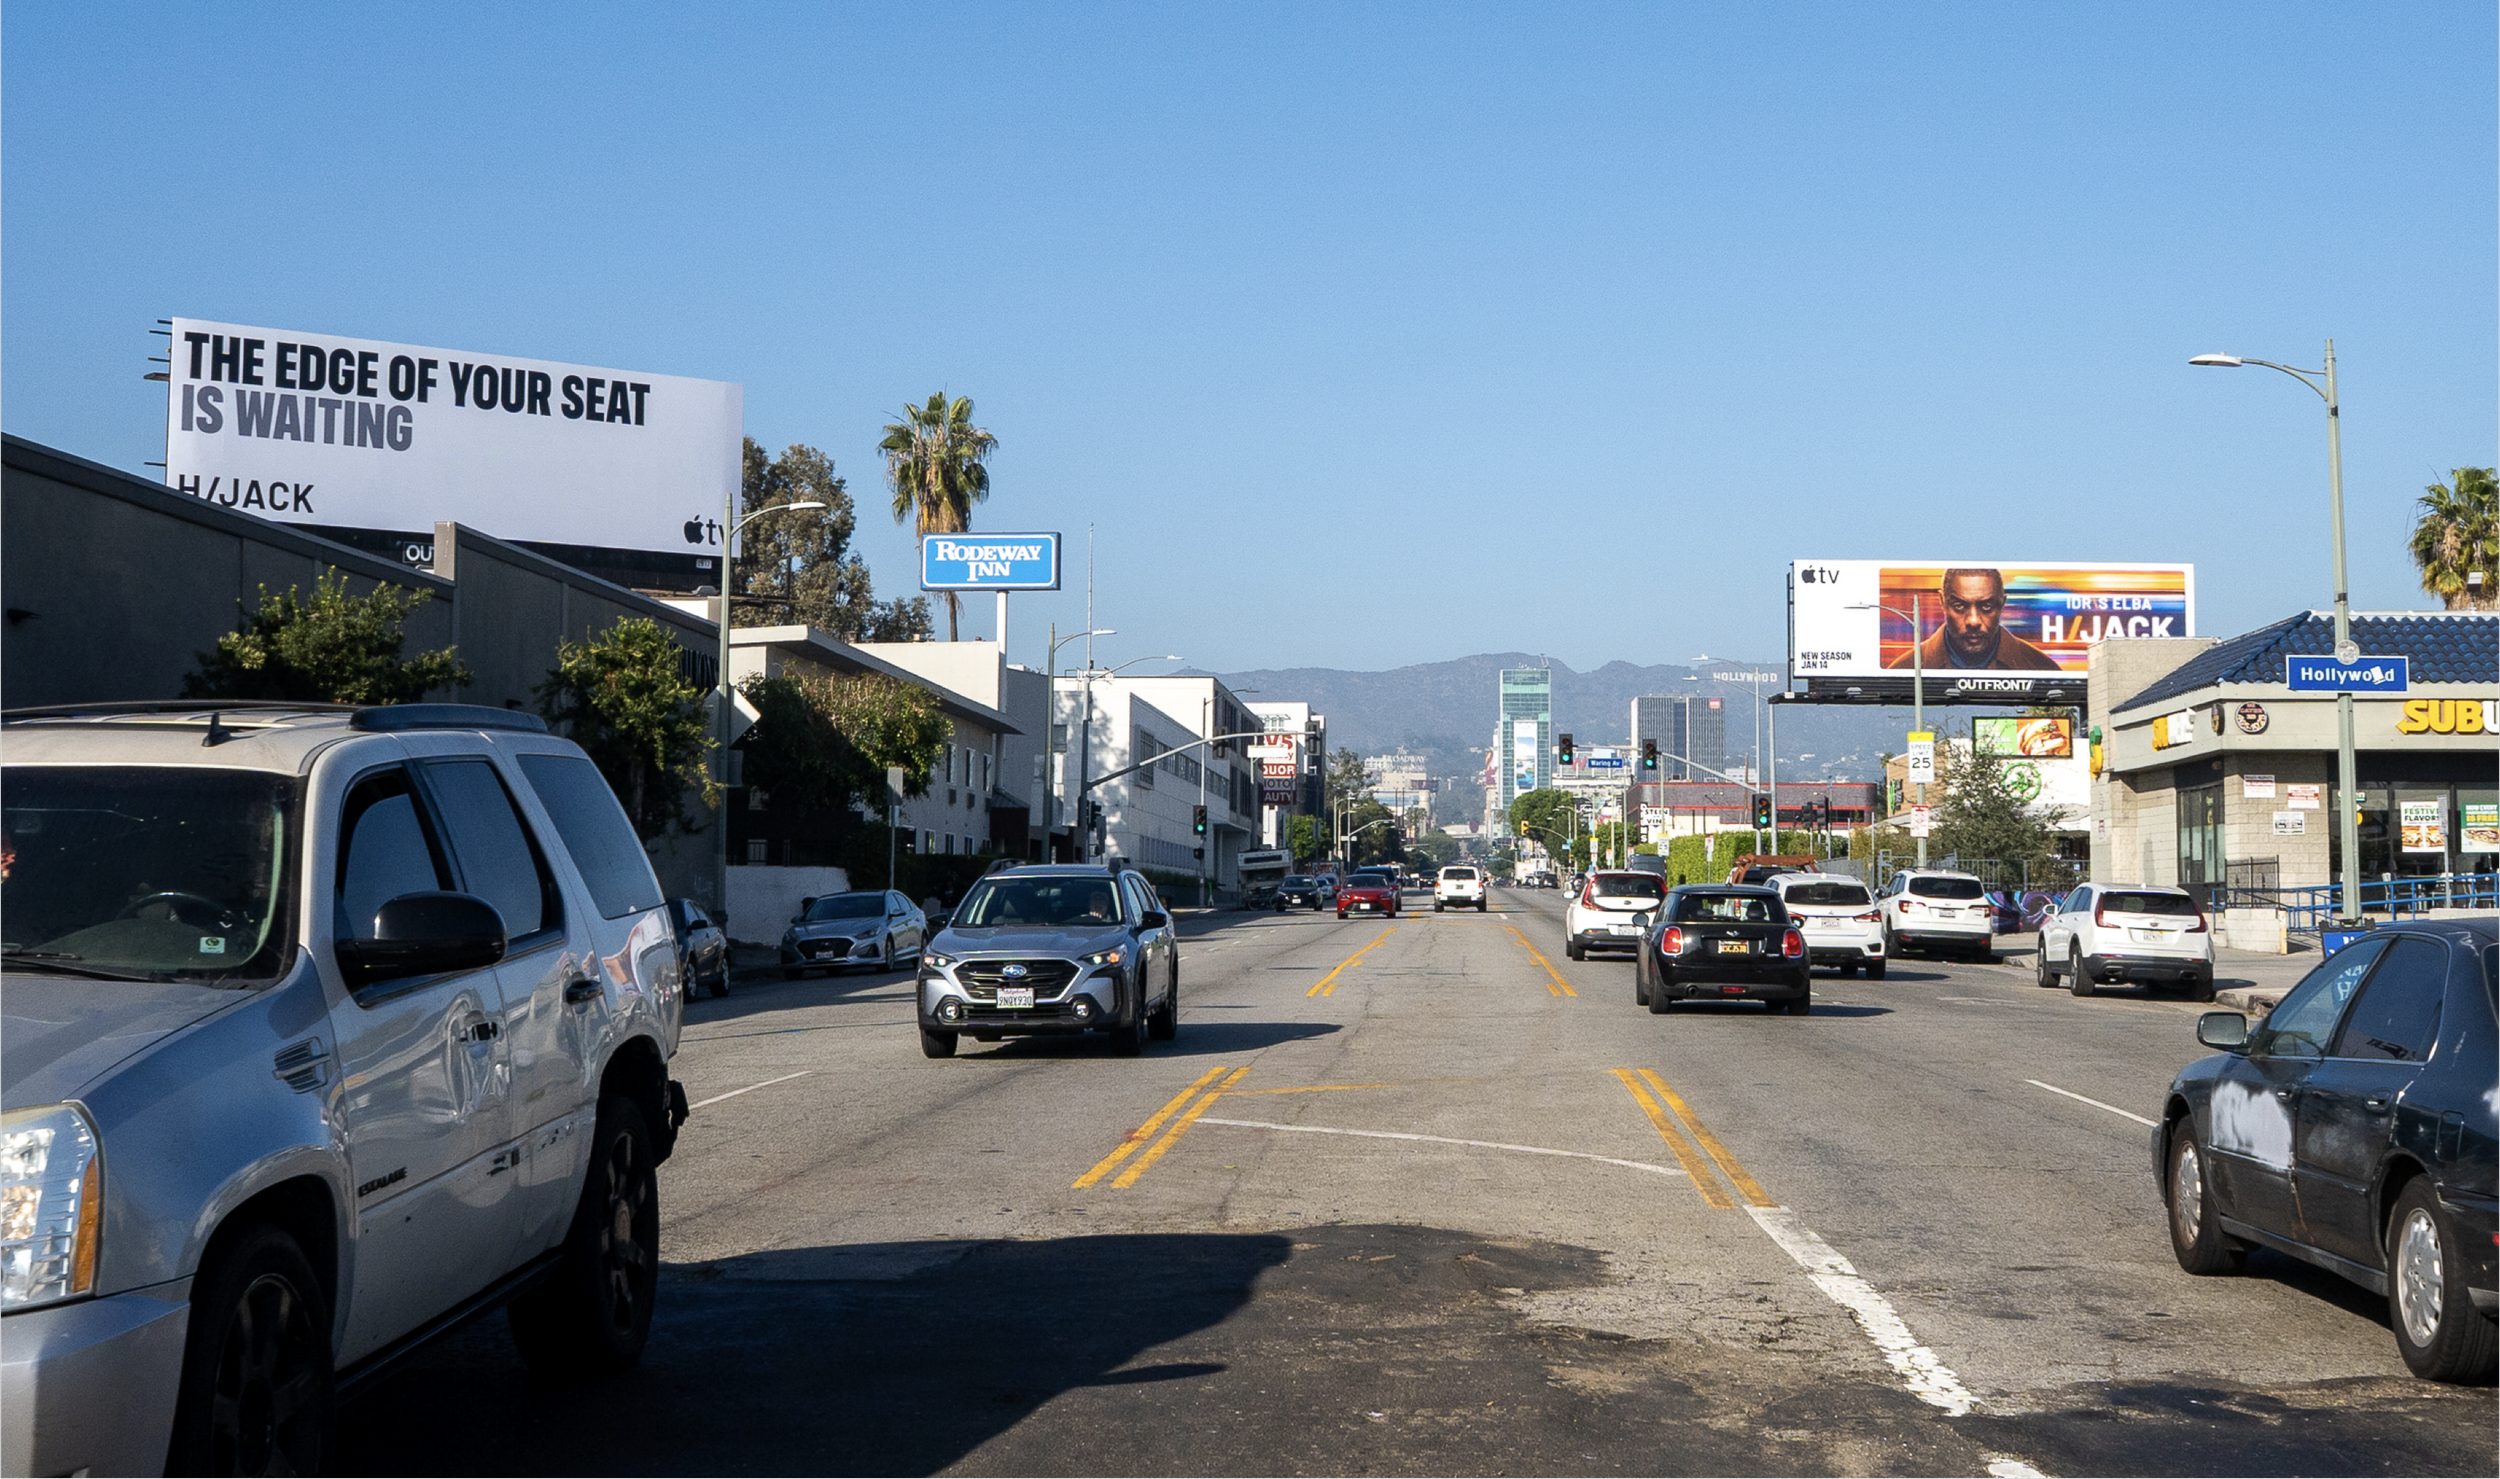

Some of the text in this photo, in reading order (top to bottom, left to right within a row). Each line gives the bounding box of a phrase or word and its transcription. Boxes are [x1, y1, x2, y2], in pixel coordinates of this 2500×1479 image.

[184, 331, 651, 426] THE EDGE OF YOUR SEAT
[181, 384, 414, 452] IS WAITING
[406, 544, 434, 562] OU
[935, 541, 1042, 562] RODEWAY
[967, 562, 1010, 582] INN
[1819, 566, 1840, 584] tv
[2112, 597, 2152, 611] ELBA
[1801, 651, 1852, 661] NEW SEASON
[1801, 661, 1828, 670] JAN 14
[2301, 667, 2395, 685] Hollywod
[1590, 759, 1611, 768] Waring
[1912, 757, 1931, 769] 25
